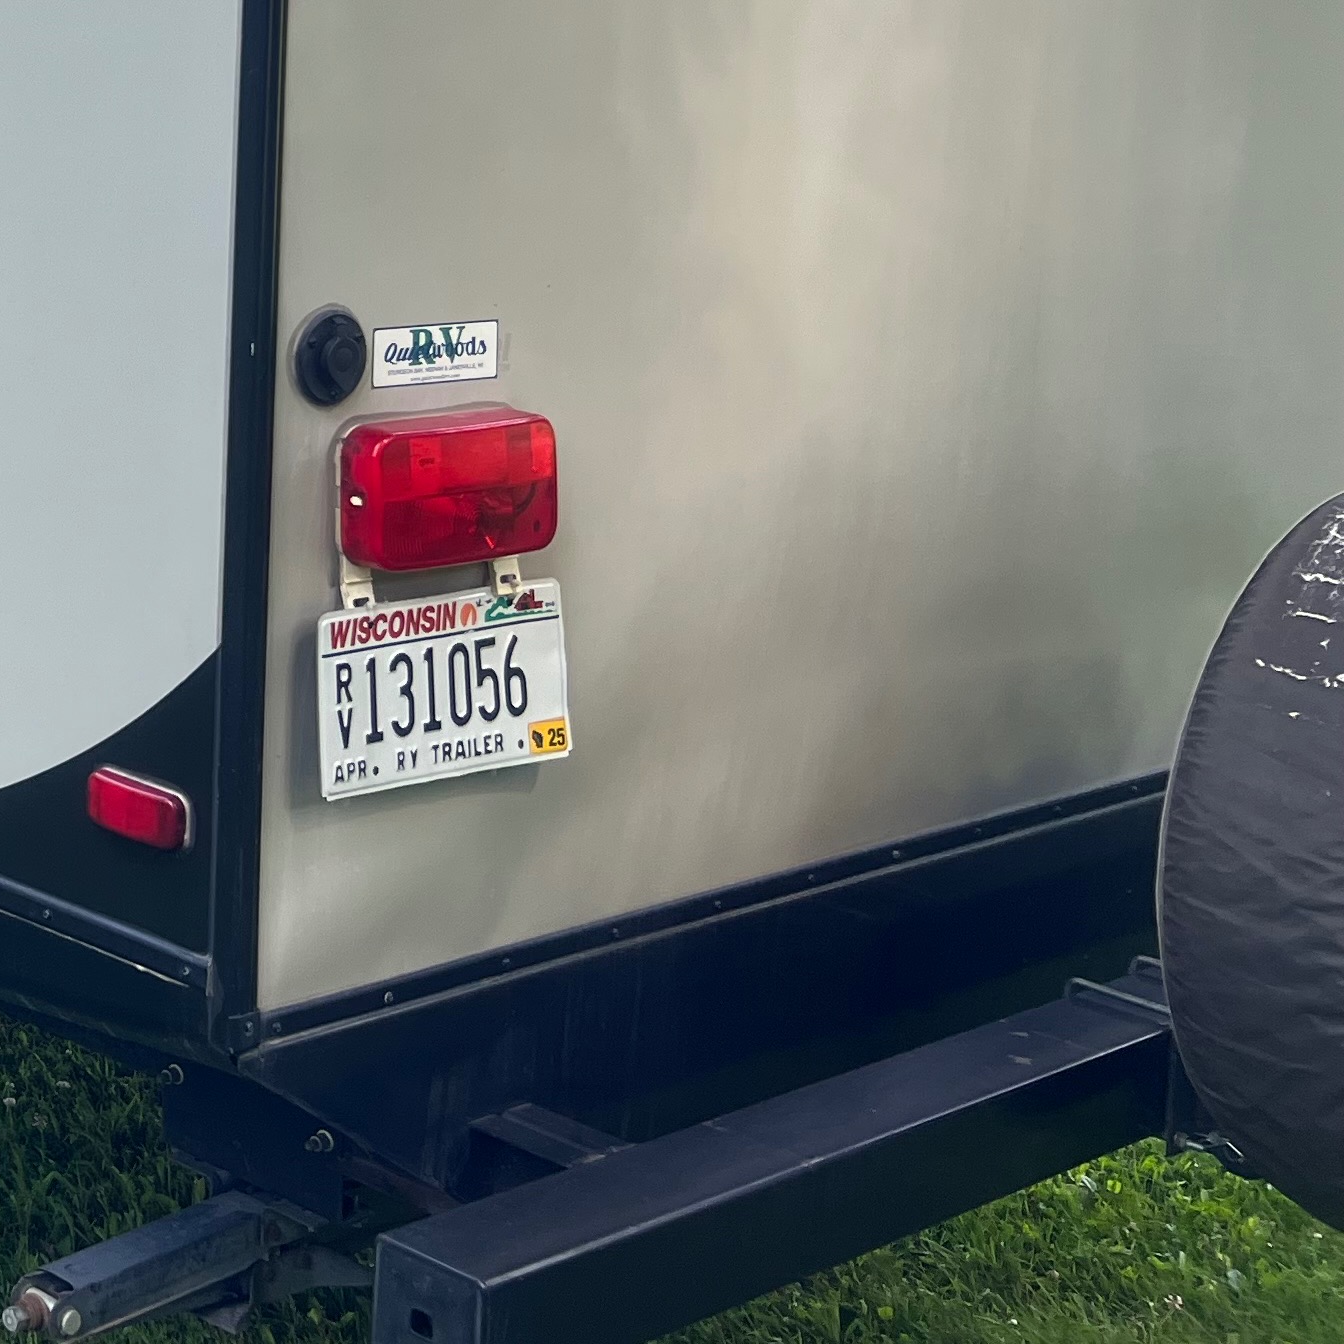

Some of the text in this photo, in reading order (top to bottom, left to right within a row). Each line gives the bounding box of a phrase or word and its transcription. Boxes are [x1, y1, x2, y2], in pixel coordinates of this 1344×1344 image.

[408, 325, 466, 367] RV
[330, 601, 457, 650] WISCONSIN
[365, 634, 529, 745] 131056
[397, 748, 418, 771] RV
[431, 732, 504, 764] TRAILER
[547, 727, 566, 747] 25
